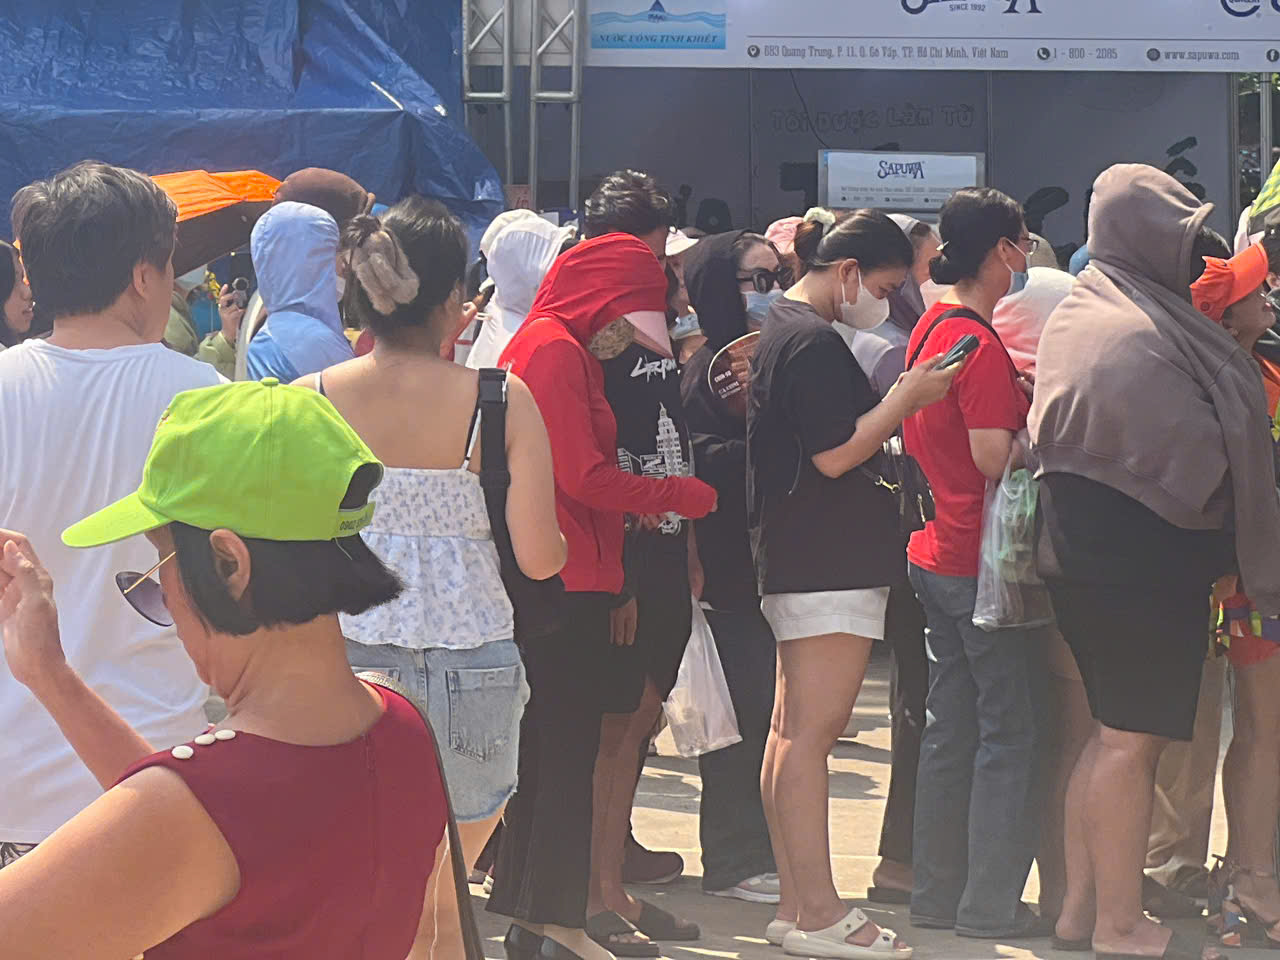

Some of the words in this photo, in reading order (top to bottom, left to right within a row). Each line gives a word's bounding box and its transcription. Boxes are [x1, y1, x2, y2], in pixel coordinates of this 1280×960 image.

[949, 3, 969, 12] SINCE
[970, 3, 986, 12] 1992
[990, 47, 1009, 59] Nam
[1164, 49, 1240, 62] www.sapuwa.com
[877, 159, 924, 179] SAPUWA
